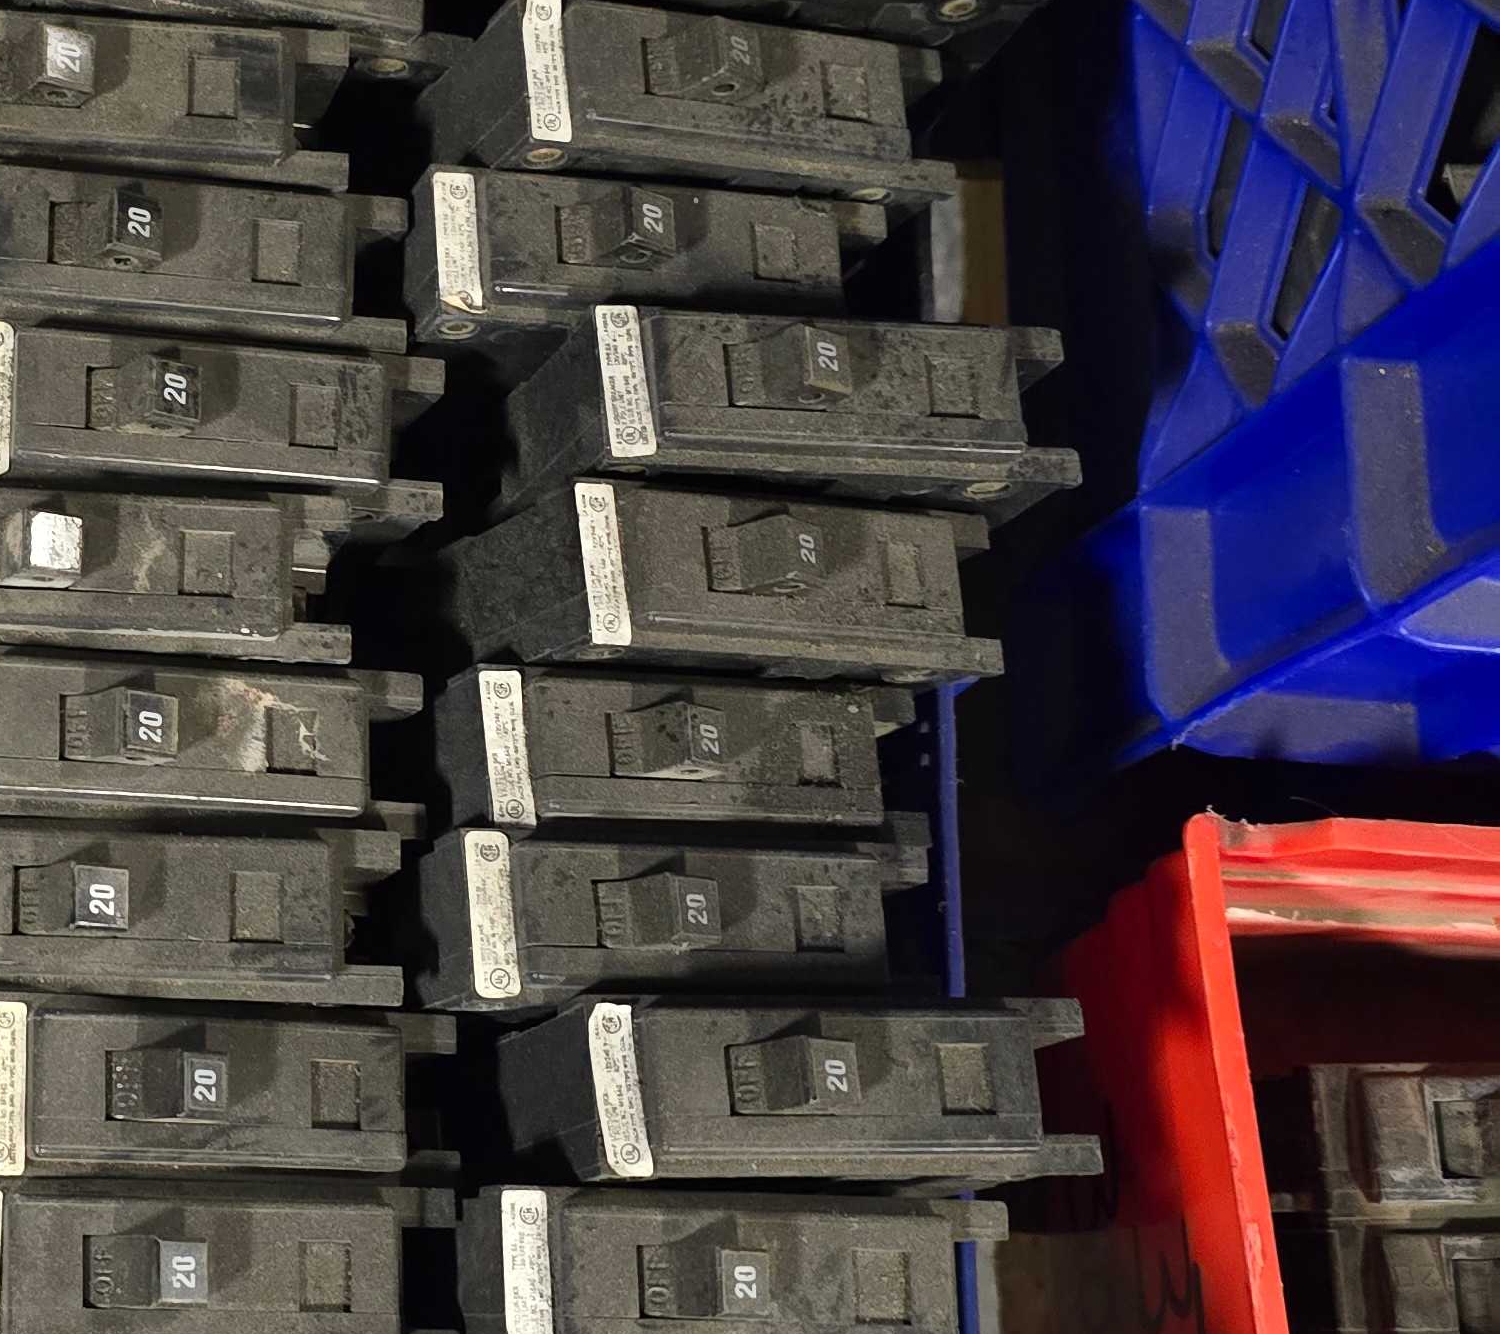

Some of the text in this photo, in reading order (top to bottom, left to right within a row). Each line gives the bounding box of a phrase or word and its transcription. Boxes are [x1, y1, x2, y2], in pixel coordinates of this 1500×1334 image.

[56, 42, 81, 73] 20
[729, 35, 749, 65] 20
[127, 207, 152, 237] 20
[643, 203, 664, 234] 20
[817, 341, 840, 372] 20
[163, 373, 188, 405] 20
[798, 533, 817, 564] 20
[139, 711, 163, 743] 20
[700, 724, 720, 755] 20
[90, 884, 115, 916] 20
[686, 894, 708, 925] 20
[194, 1069, 217, 1102] 20
[735, 1057, 760, 1105] OFF
[825, 1060, 848, 1091] 20
[95, 1247, 112, 1295] OFF
[172, 1255, 196, 1288] 20
[647, 1254, 672, 1305] OFF
[735, 1265, 757, 1298] 20
